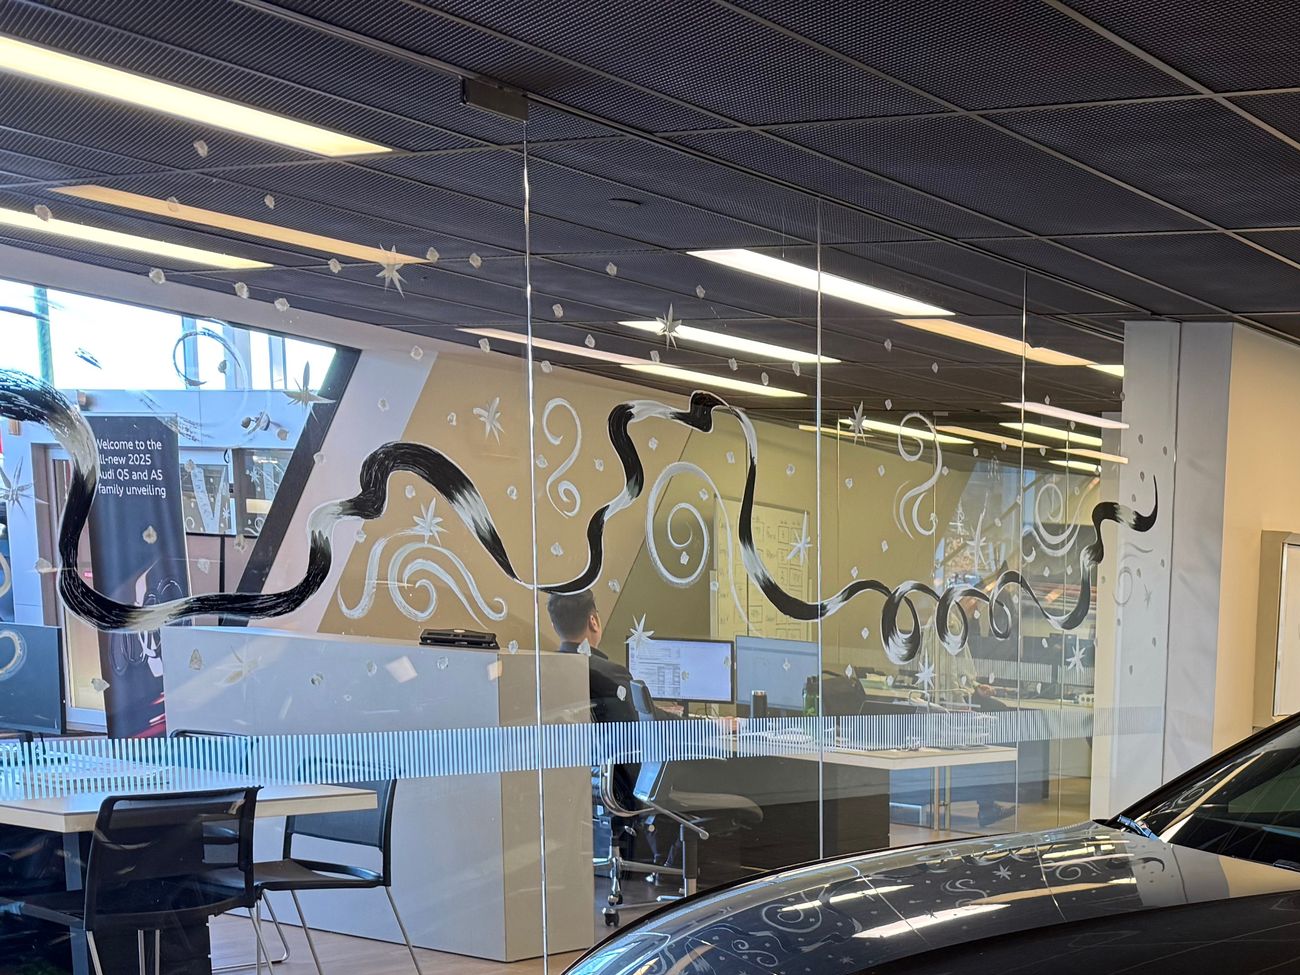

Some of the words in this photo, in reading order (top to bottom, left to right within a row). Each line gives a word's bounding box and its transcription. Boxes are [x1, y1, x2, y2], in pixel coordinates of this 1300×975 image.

[135, 440, 145, 450] to
[147, 439, 162, 450] the
[99, 454, 126, 464] ll-new
[128, 454, 151, 465] 2025
[117, 469, 129, 481] Q5
[132, 470, 148, 480] and
[151, 470, 163, 480] A5
[98, 483, 123, 497] family
[126, 484, 166, 498] unveiling
